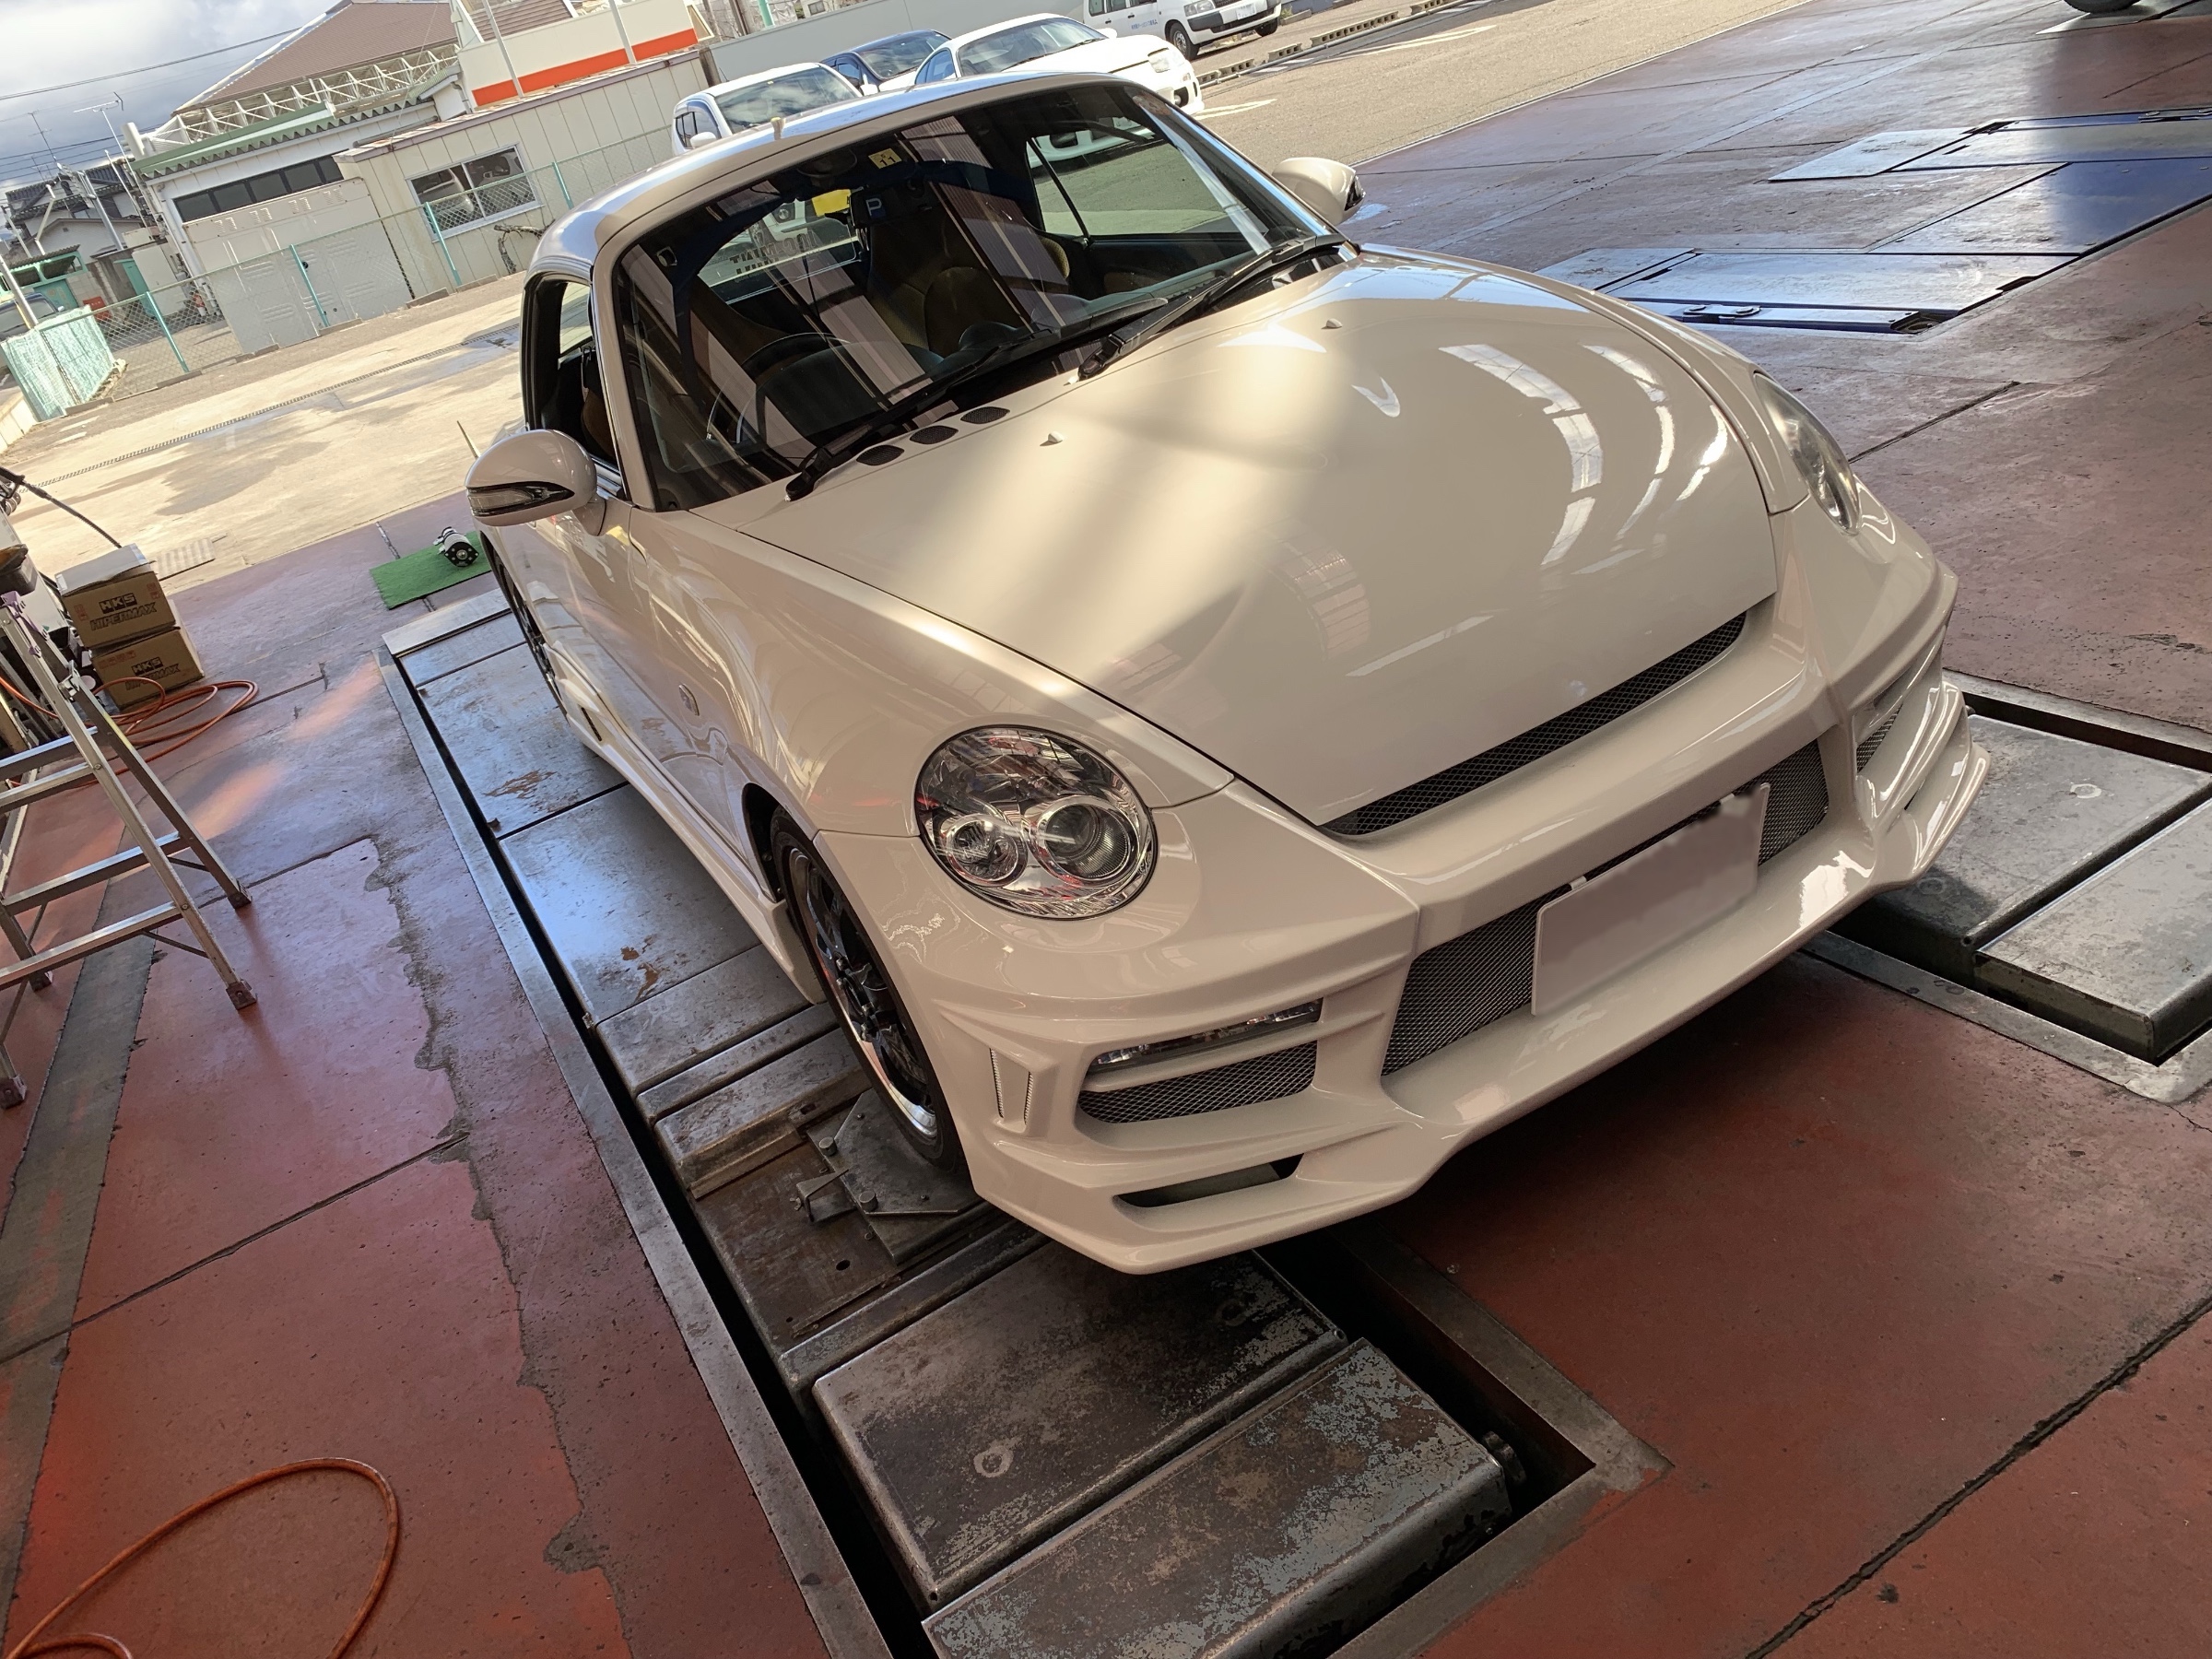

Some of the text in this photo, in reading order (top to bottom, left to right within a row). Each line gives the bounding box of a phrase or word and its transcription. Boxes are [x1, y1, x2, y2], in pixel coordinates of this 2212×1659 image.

[879, 156, 896, 166] 11
[865, 197, 882, 217] P
[99, 593, 137, 614] HKS
[89, 602, 157, 631] HIPERMAX
[131, 656, 163, 677] HKS
